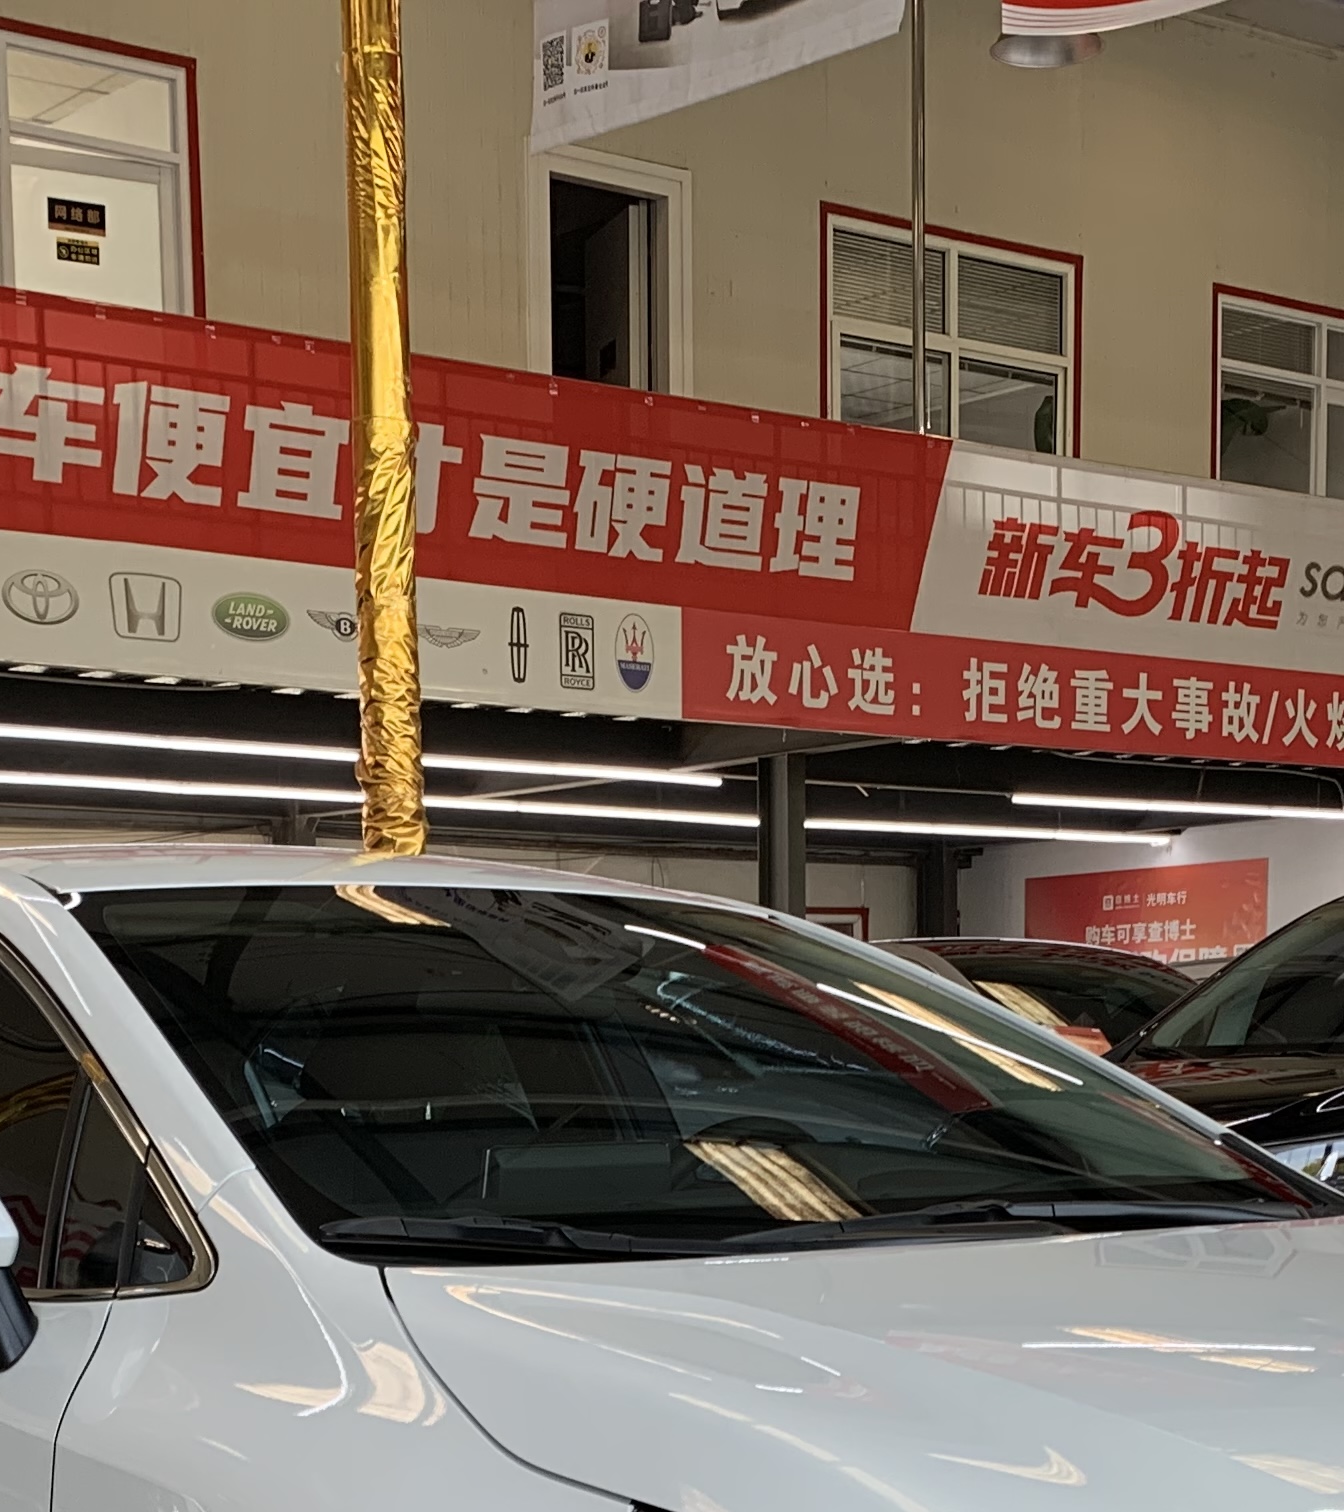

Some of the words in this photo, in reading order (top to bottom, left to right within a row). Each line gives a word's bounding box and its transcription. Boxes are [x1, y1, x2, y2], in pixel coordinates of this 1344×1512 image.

[978, 509, 1291, 631] 新车3折起
[562, 616, 591, 628] ROLLS
[563, 677, 591, 688] ROYCE
